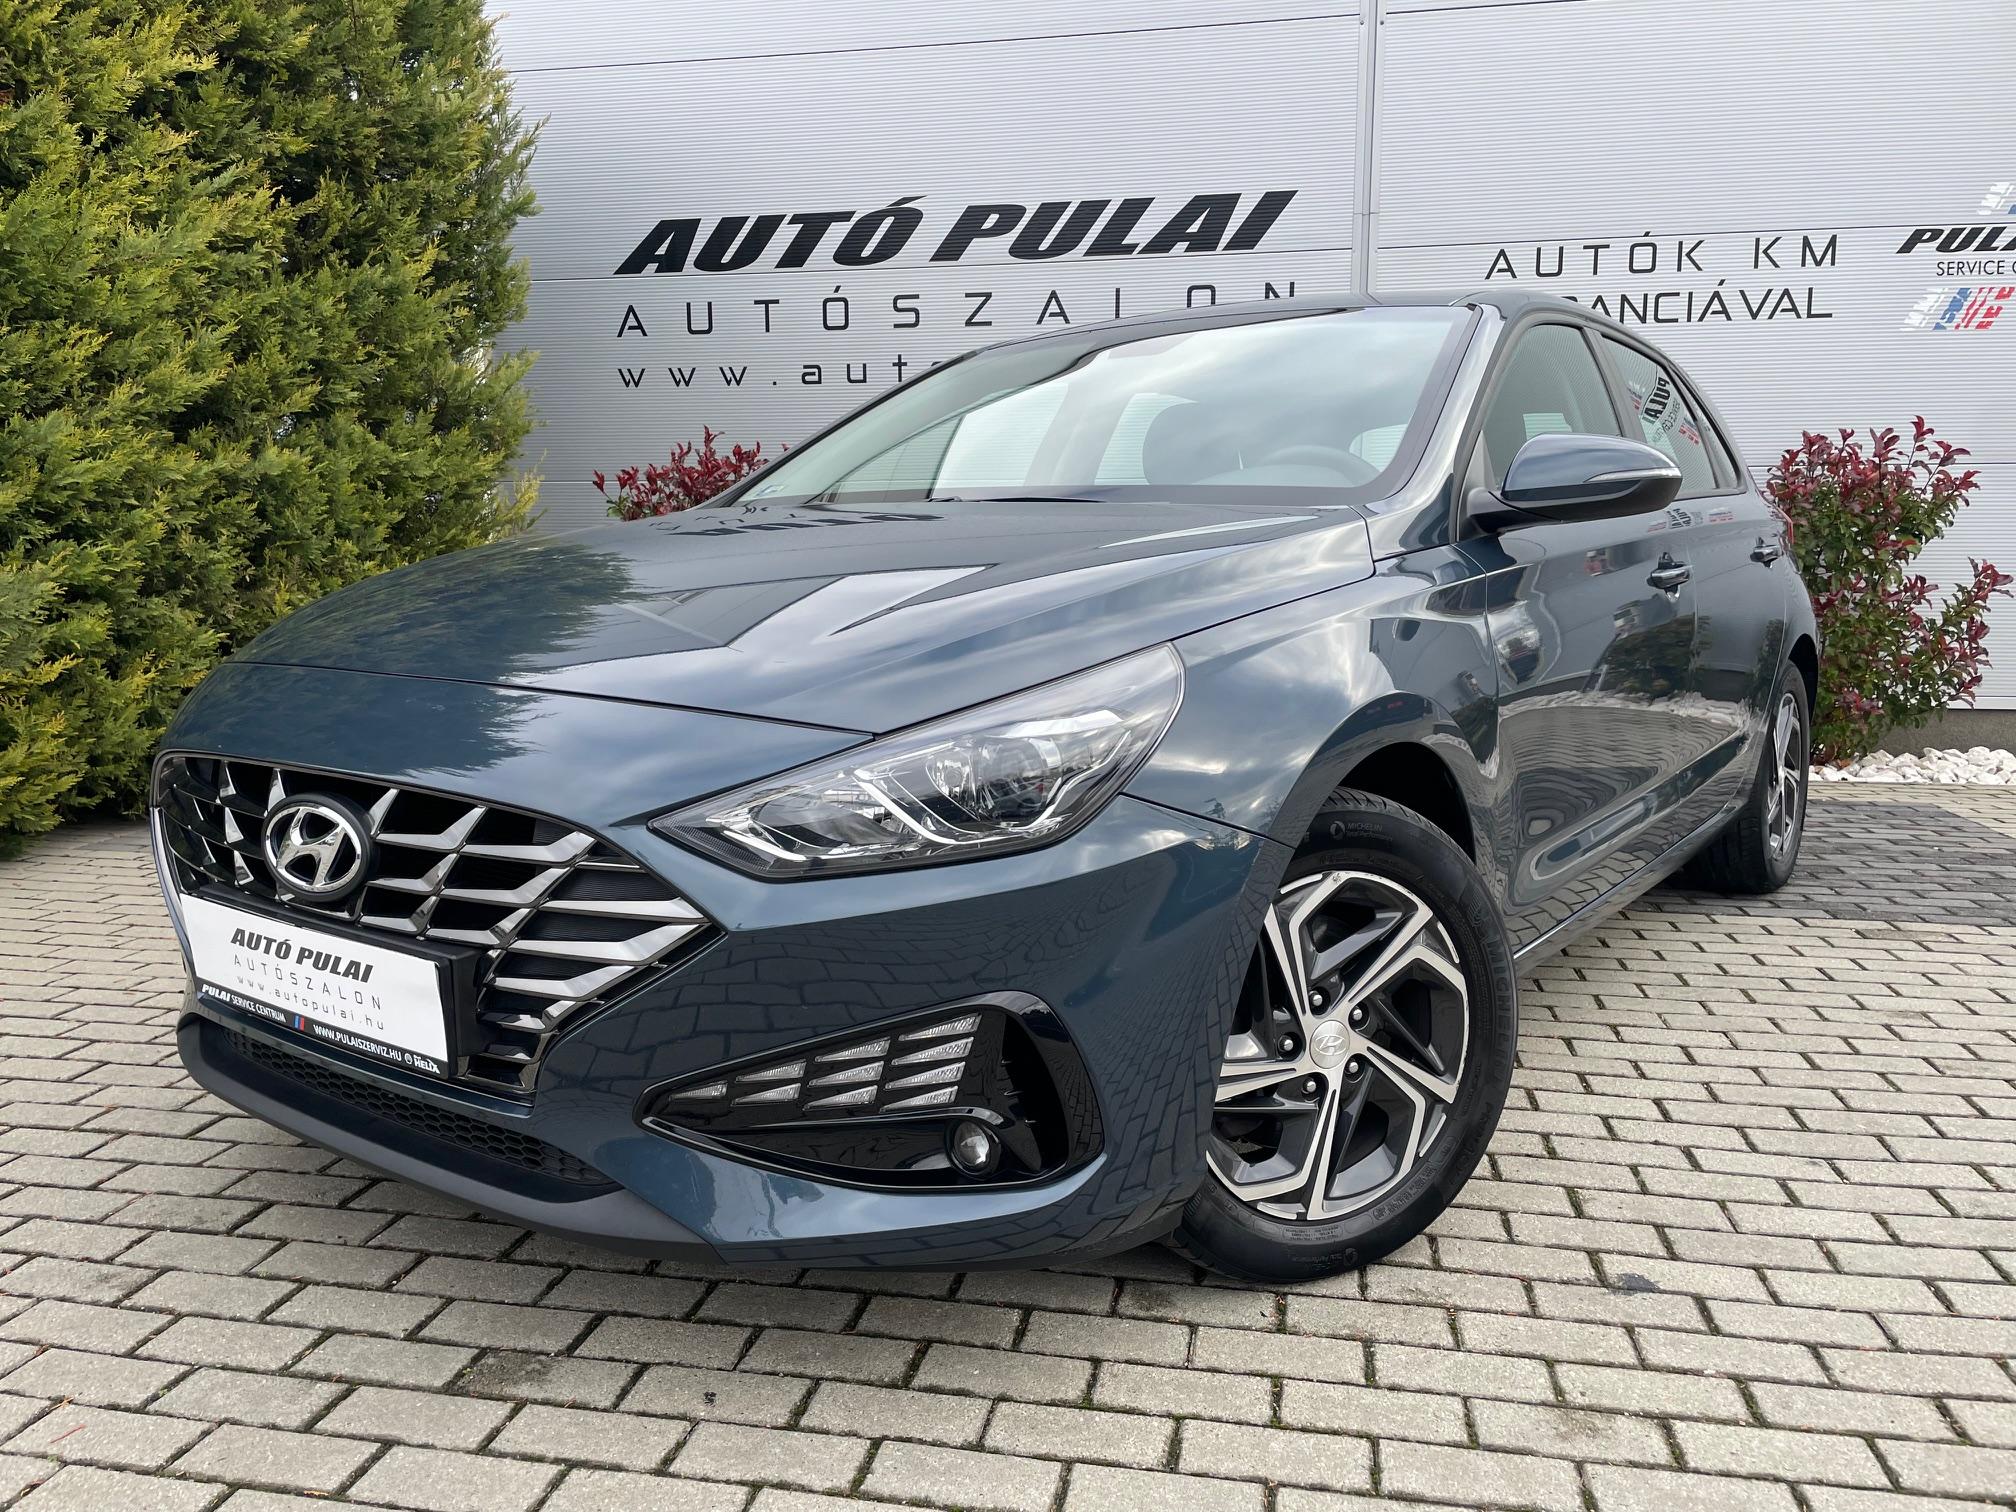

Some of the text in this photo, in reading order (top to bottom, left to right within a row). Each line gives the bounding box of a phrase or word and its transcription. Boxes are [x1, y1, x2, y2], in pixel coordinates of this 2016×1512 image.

[613, 189, 1299, 275] AUTÓ PULAI
[1484, 231, 1838, 280] AUTÓK KM
[1936, 260, 2005, 276] SERVICE
[1562, 279, 1833, 324] ANCIÁVAL
[617, 354, 941, 388] www.aut
[230, 928, 374, 983] AUTÓ PULAI
[234, 954, 382, 1010] AUTÓSZALON
[202, 983, 230, 1002] PULAI
[231, 994, 256, 1012] SERVICE
[256, 1003, 287, 1023] CENTRUM
[313, 1024, 402, 1062] WWW.PULAISZERVIZ.HU
[237, 976, 384, 1030] www.autopulai.hu
